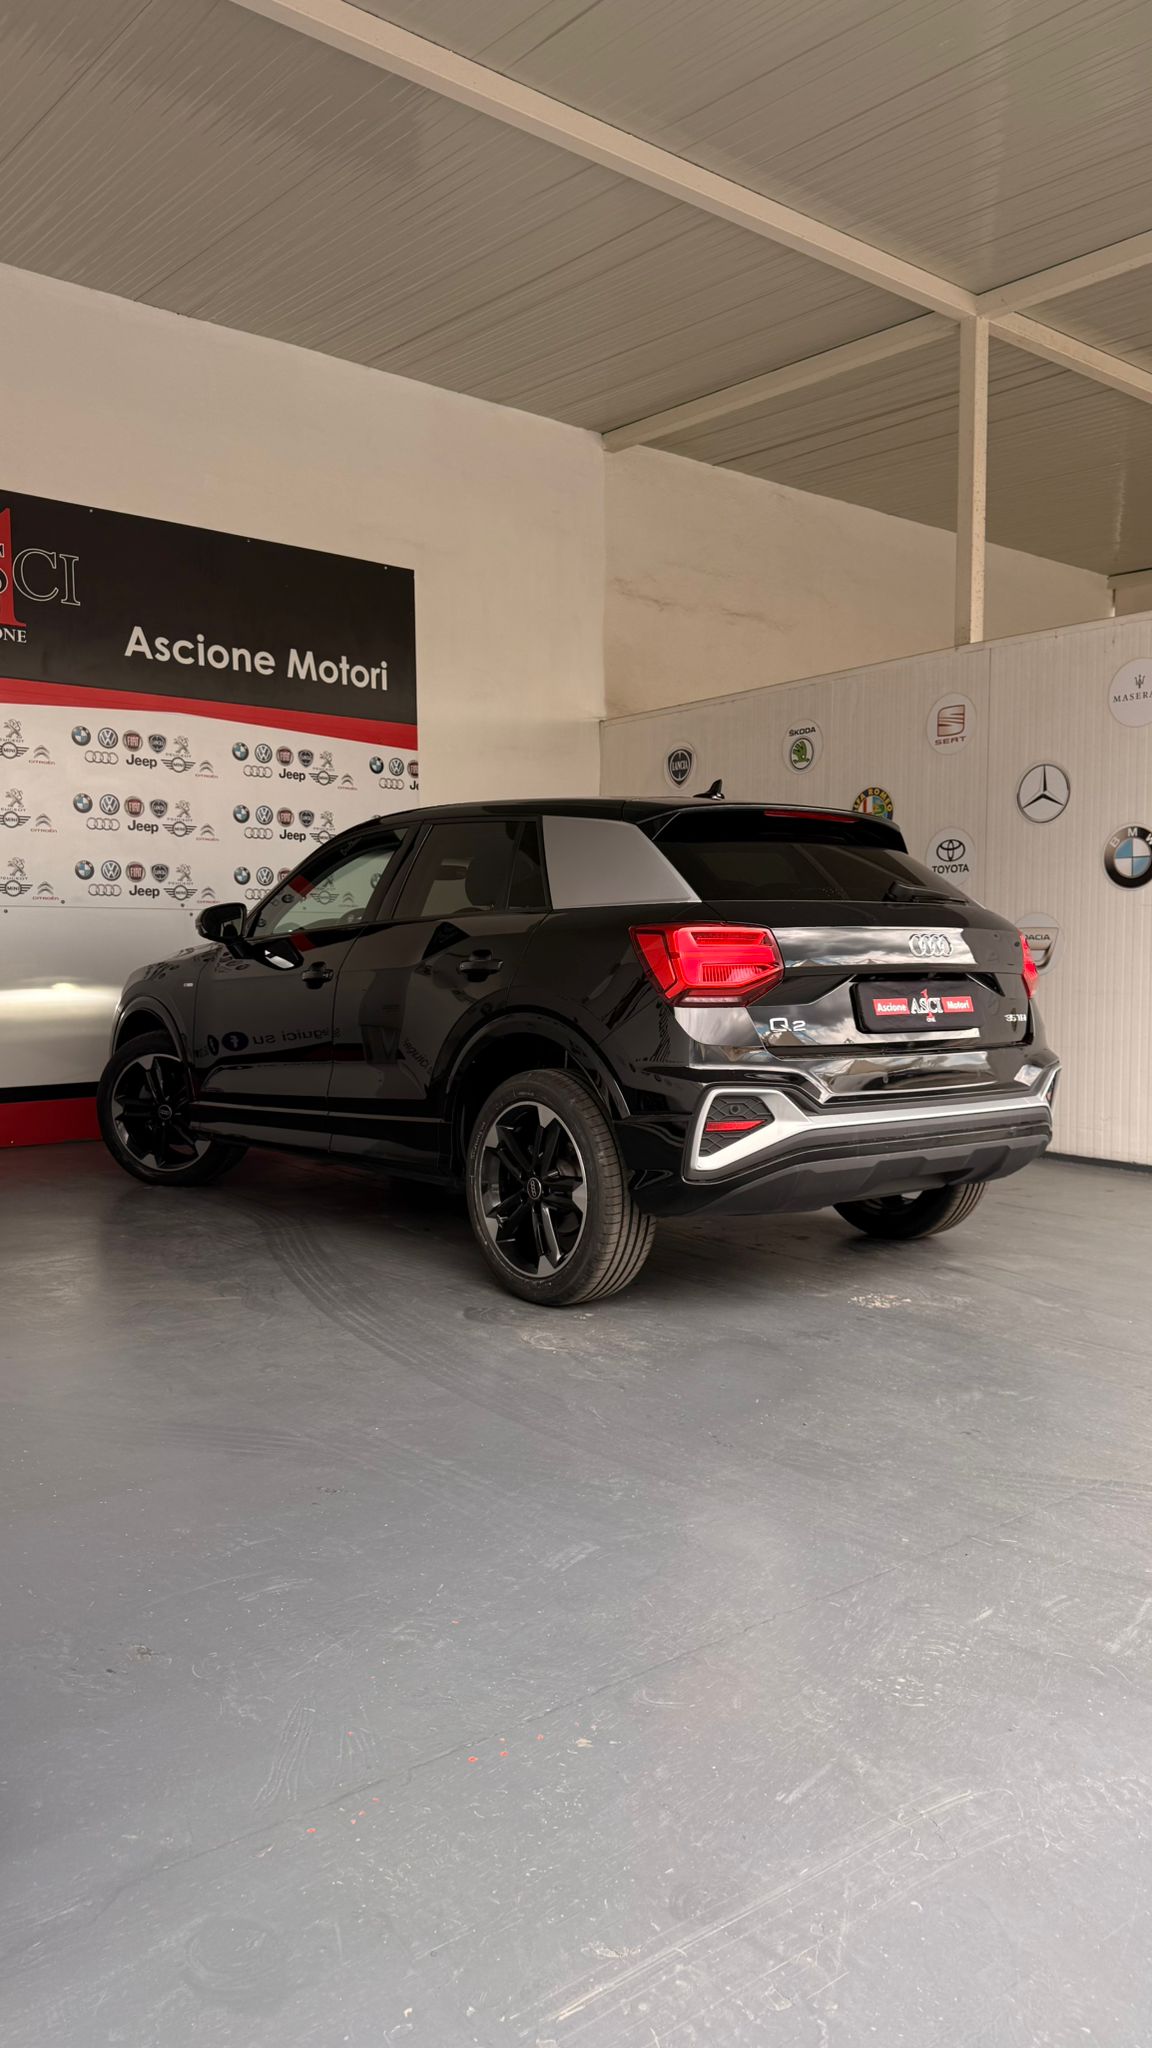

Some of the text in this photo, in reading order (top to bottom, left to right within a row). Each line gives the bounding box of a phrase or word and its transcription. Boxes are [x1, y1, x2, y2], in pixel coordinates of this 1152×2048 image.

[0, 542, 81, 606] CI
[124, 625, 388, 691] Ascione Motori
[934, 736, 966, 745] SEAT
[126, 753, 158, 770] Jeep
[278, 767, 306, 783] Jeep
[127, 819, 159, 835] Jeep
[279, 829, 307, 842] Jeep
[932, 863, 970, 874] TOYOTA
[129, 884, 161, 899] Jeep
[877, 1002, 907, 1012] Ascione
[946, 1000, 970, 1010] Motori
[770, 1017, 806, 1032] Q2
